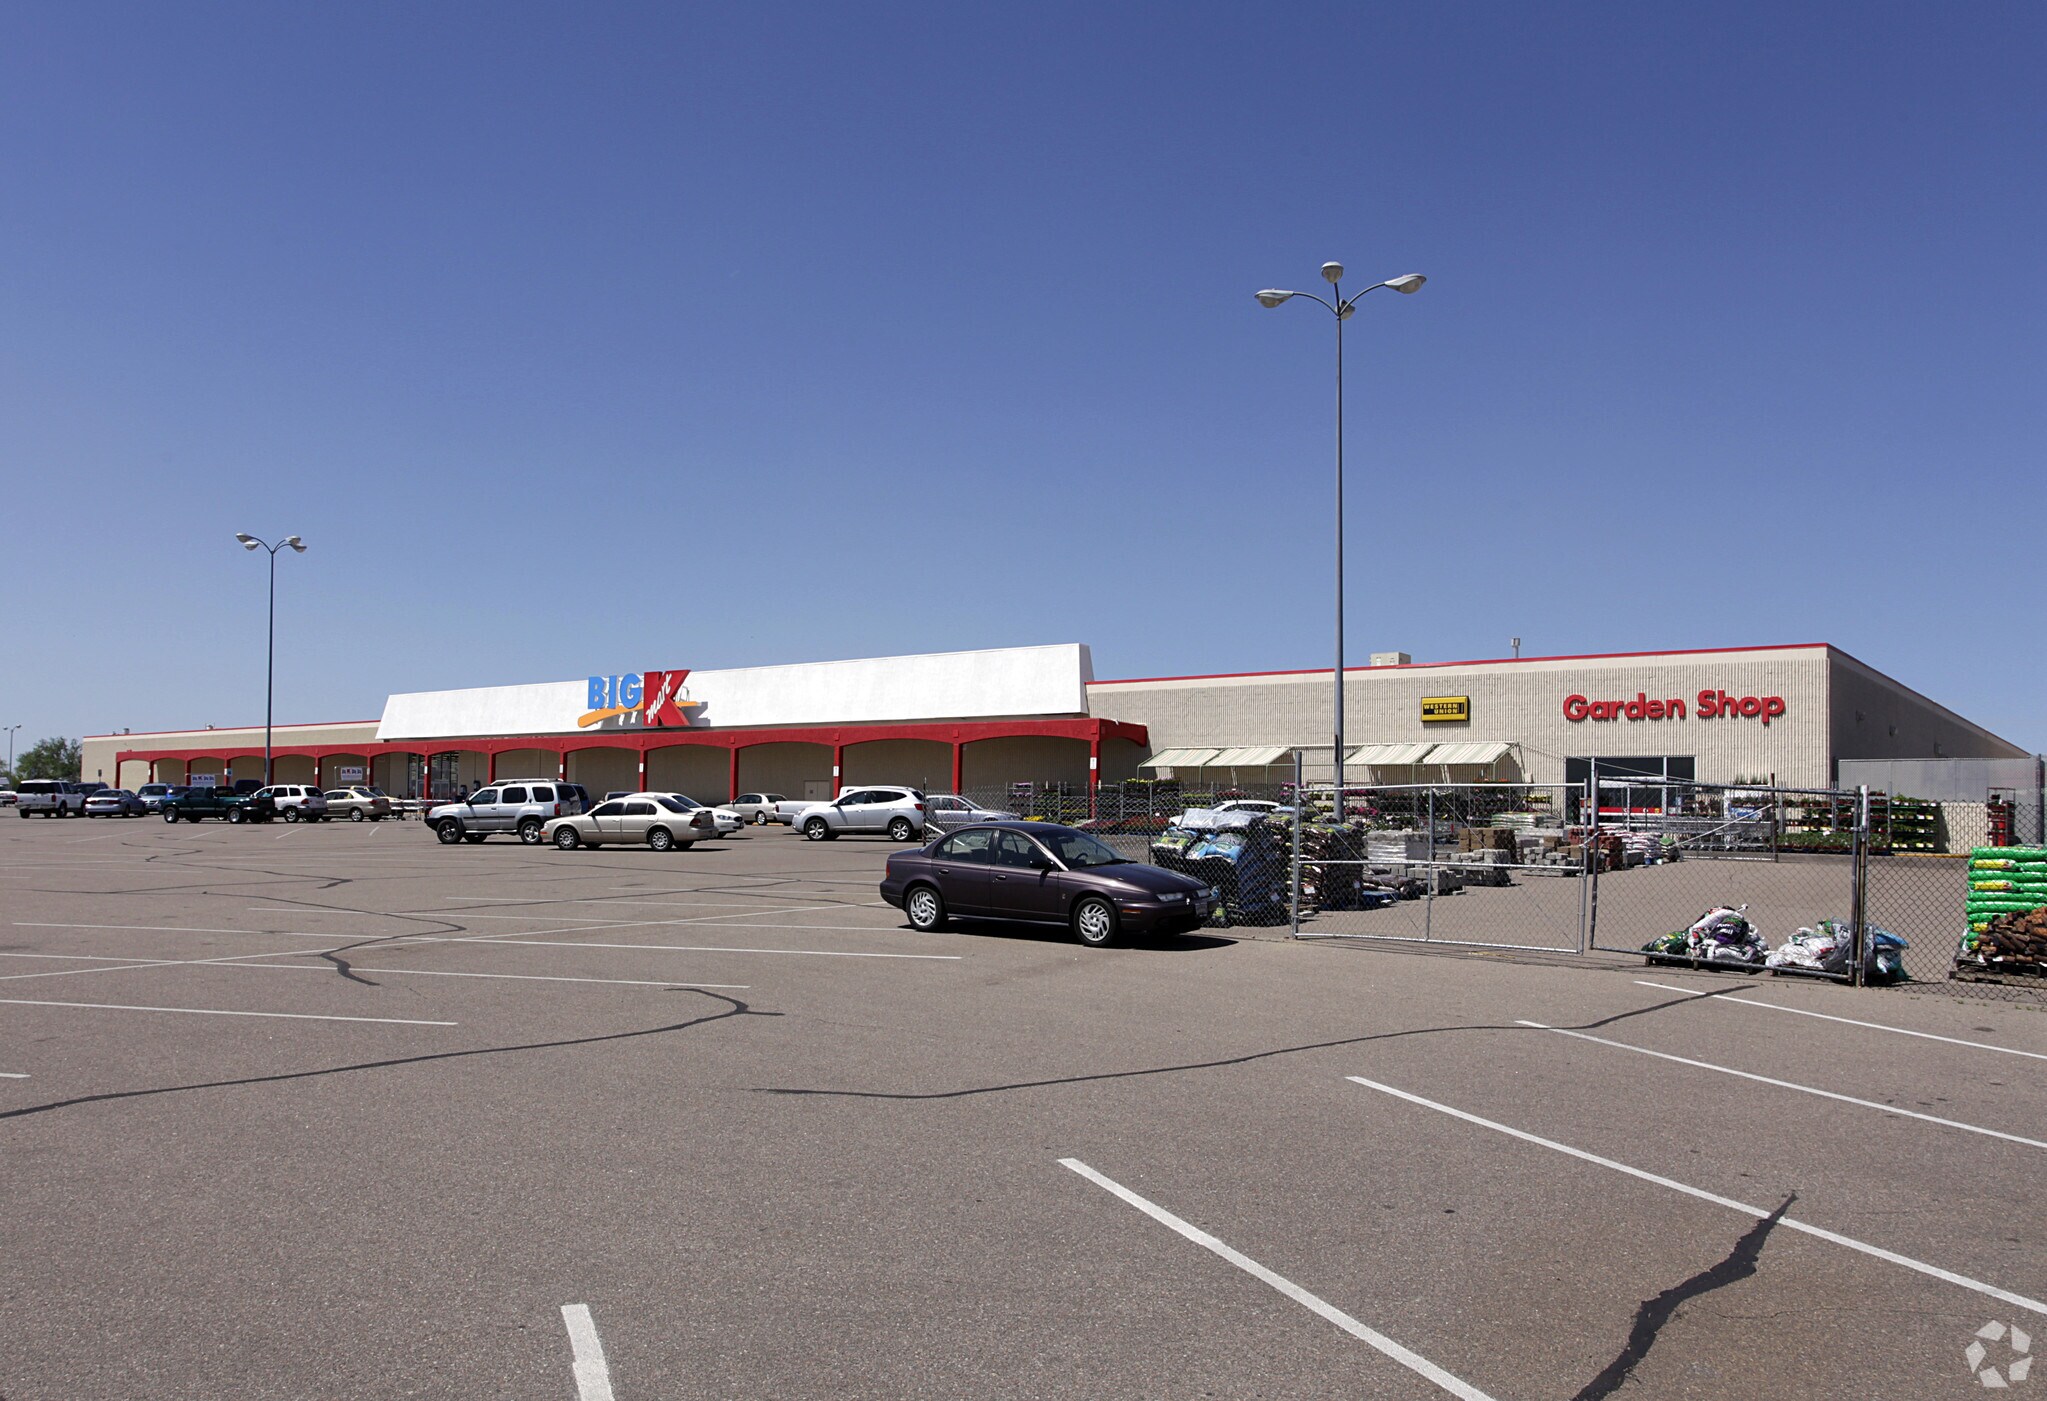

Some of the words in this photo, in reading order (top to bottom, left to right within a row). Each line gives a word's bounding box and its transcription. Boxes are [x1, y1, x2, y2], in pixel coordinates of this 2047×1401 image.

[588, 673, 642, 709] BIG
[1563, 692, 1686, 720] Garden
[1696, 689, 1786, 723] Shop
